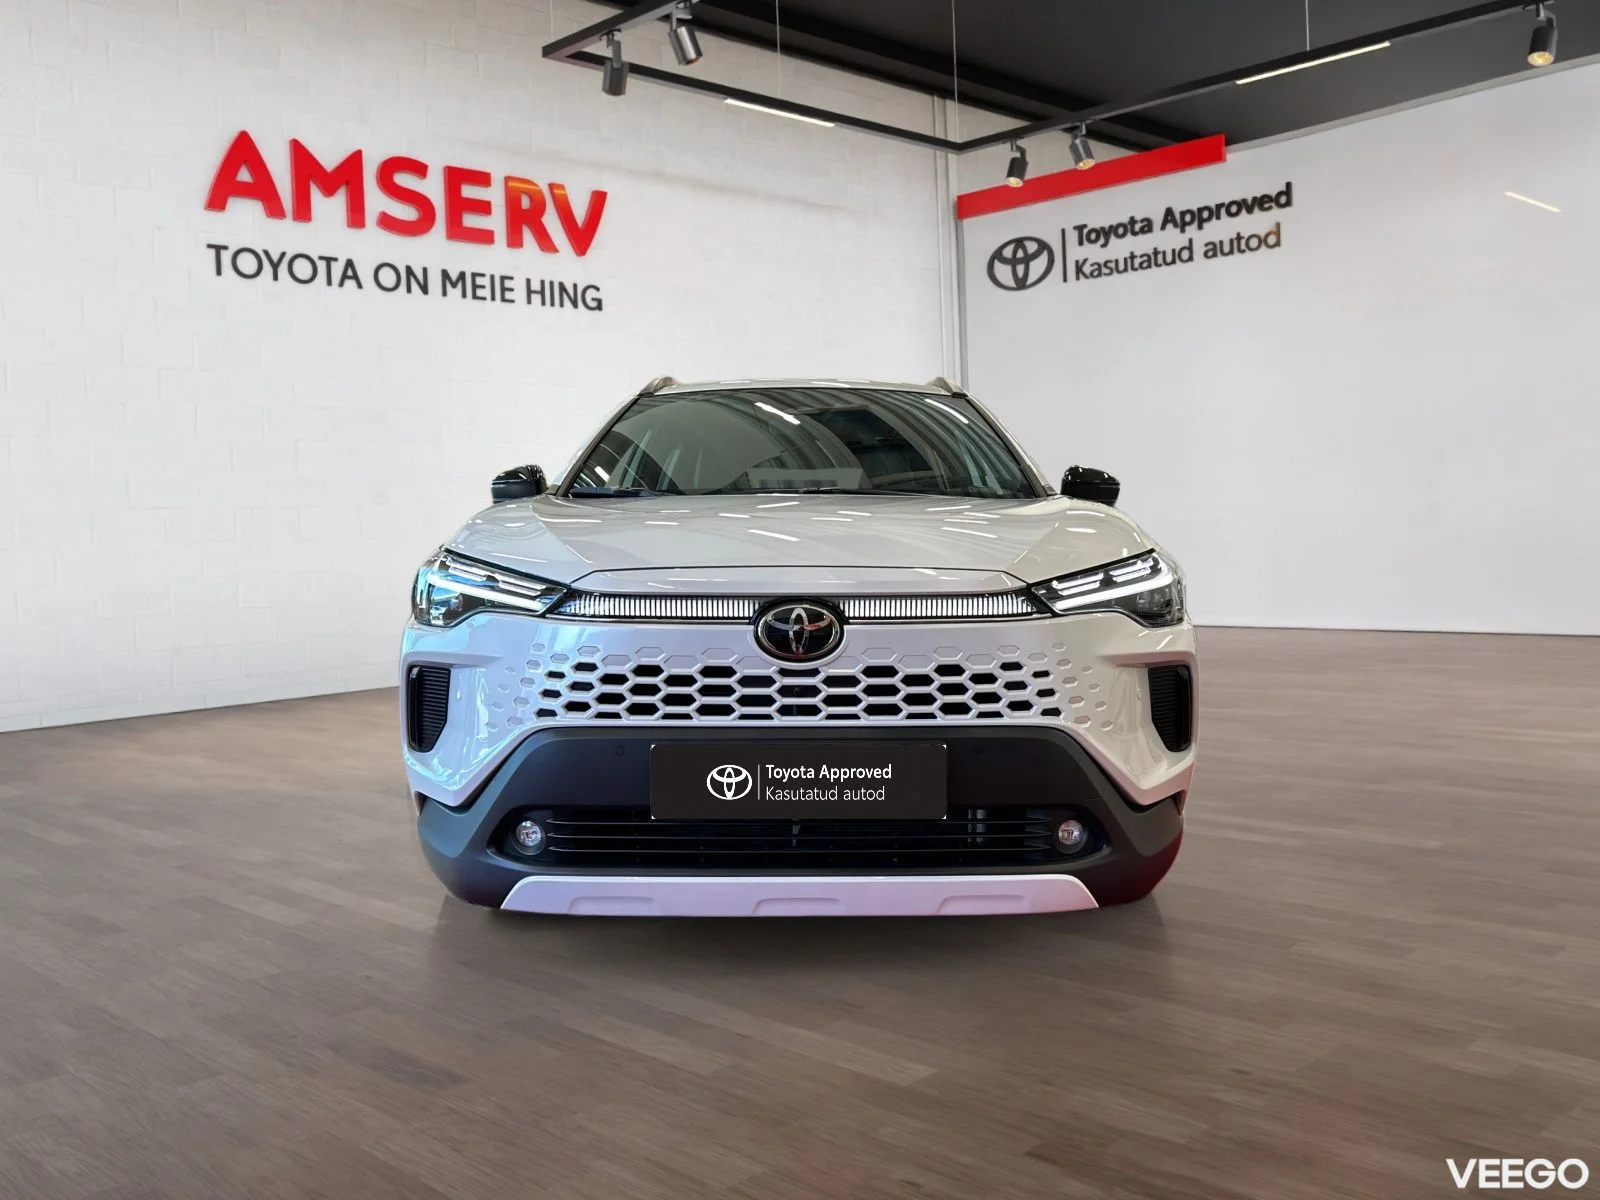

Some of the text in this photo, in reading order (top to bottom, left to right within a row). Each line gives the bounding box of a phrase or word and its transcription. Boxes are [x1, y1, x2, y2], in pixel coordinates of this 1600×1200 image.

[204, 130, 607, 257] AMSERV
[1073, 181, 1293, 248] Toyota Approved
[207, 243, 603, 311] TOYOTA ON MEIE HING
[1075, 222, 1281, 281] Kasutatud autod
[765, 763, 892, 782] Toyota Approved
[765, 786, 885, 801] Kasutatud autod
